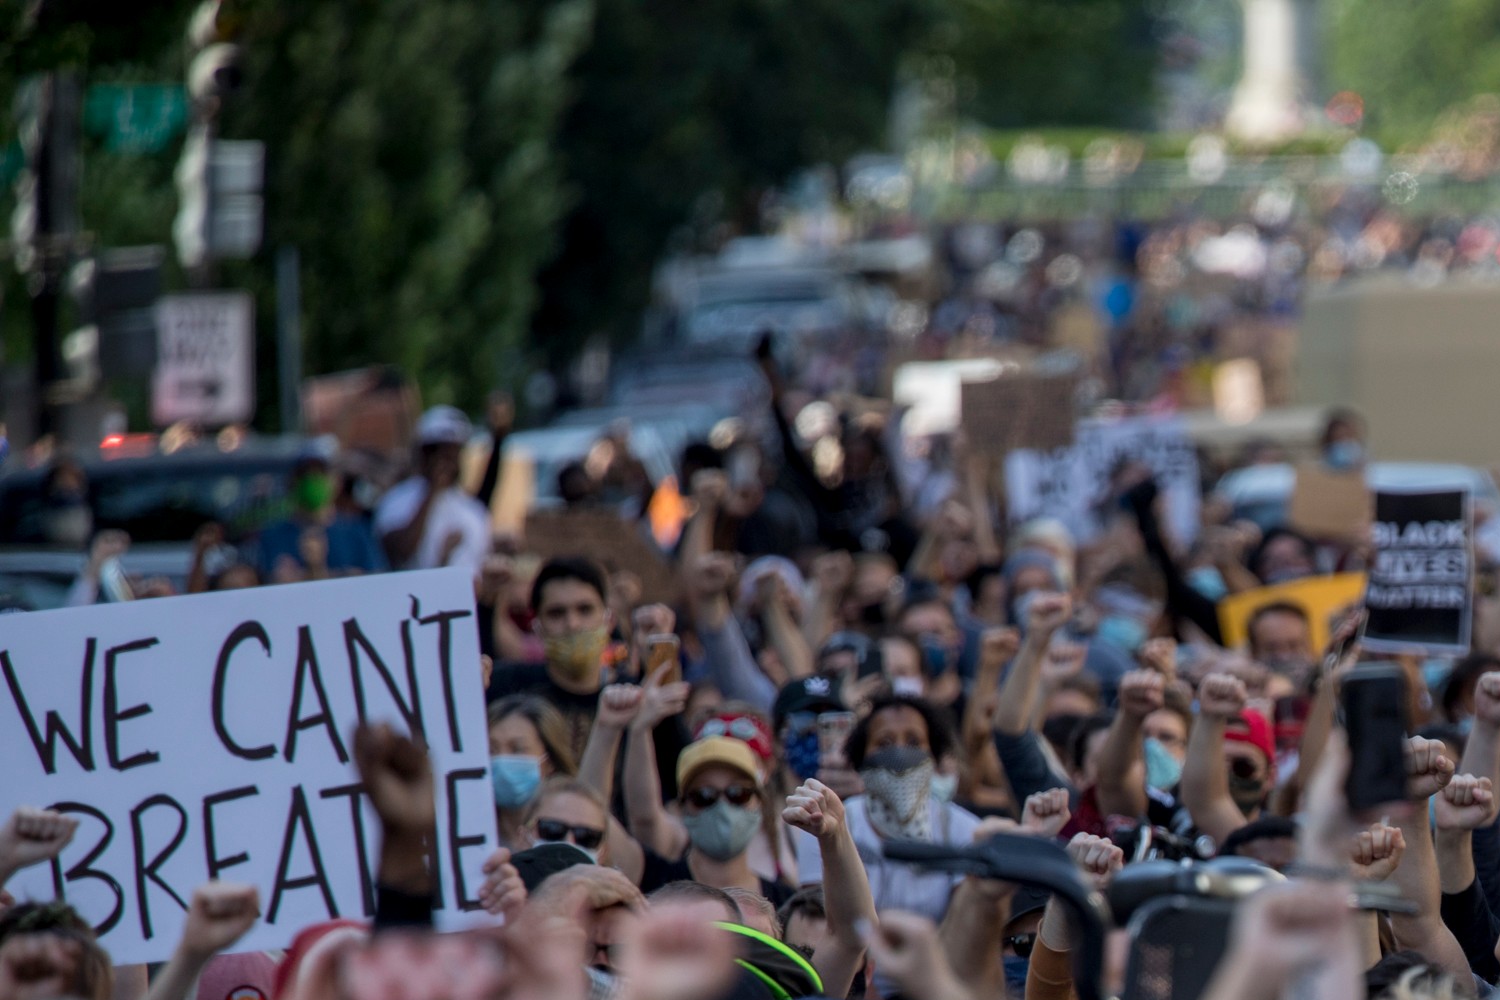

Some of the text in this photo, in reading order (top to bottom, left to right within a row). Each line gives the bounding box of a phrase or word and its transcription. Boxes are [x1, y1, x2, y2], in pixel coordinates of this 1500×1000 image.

[1373, 520, 1466, 547] BLACK
[1374, 551, 1464, 582] LIVES
[0, 594, 472, 774] WE CAN'T
